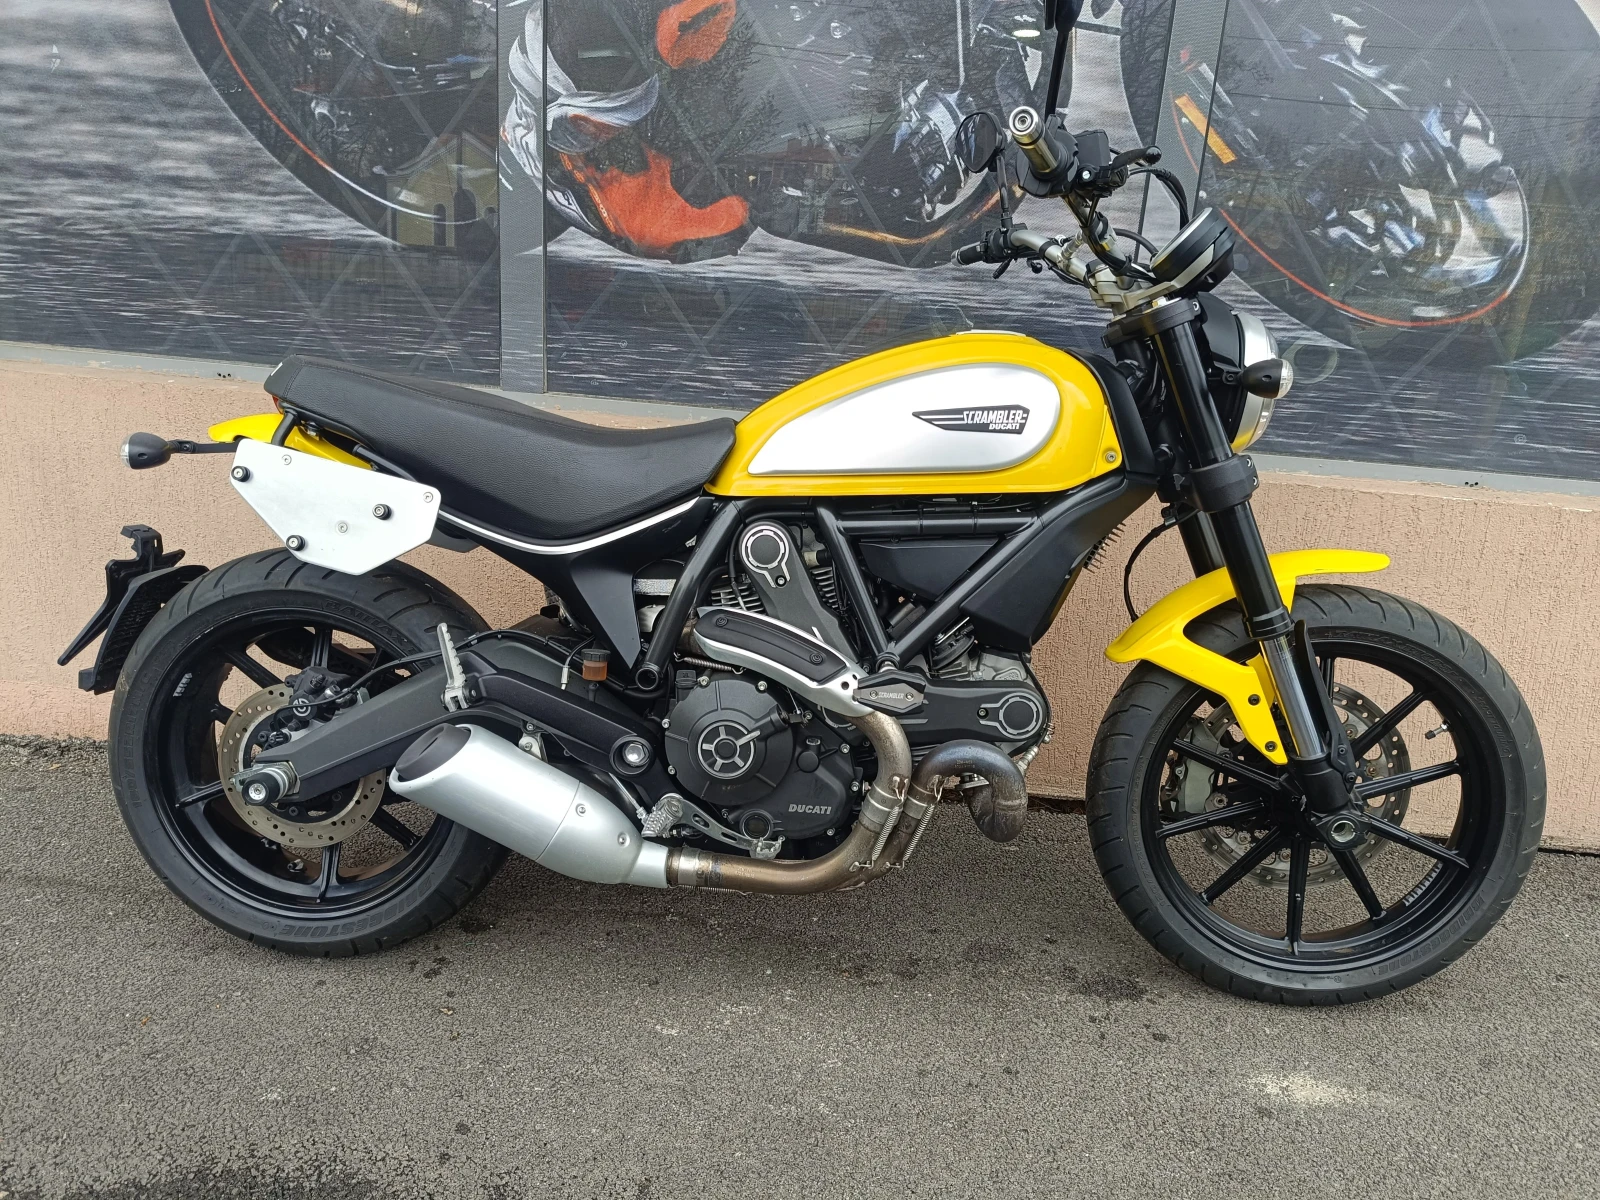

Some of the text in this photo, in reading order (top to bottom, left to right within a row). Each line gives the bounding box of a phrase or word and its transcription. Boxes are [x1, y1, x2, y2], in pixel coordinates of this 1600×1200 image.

[963, 410, 1022, 424] SCRAMBLER
[878, 691, 905, 700] SCRAMBLER
[788, 803, 832, 815] DUCATI
[278, 875, 434, 939] BRIDGESTONE
[1378, 893, 1486, 976] BRIDGESTONE
